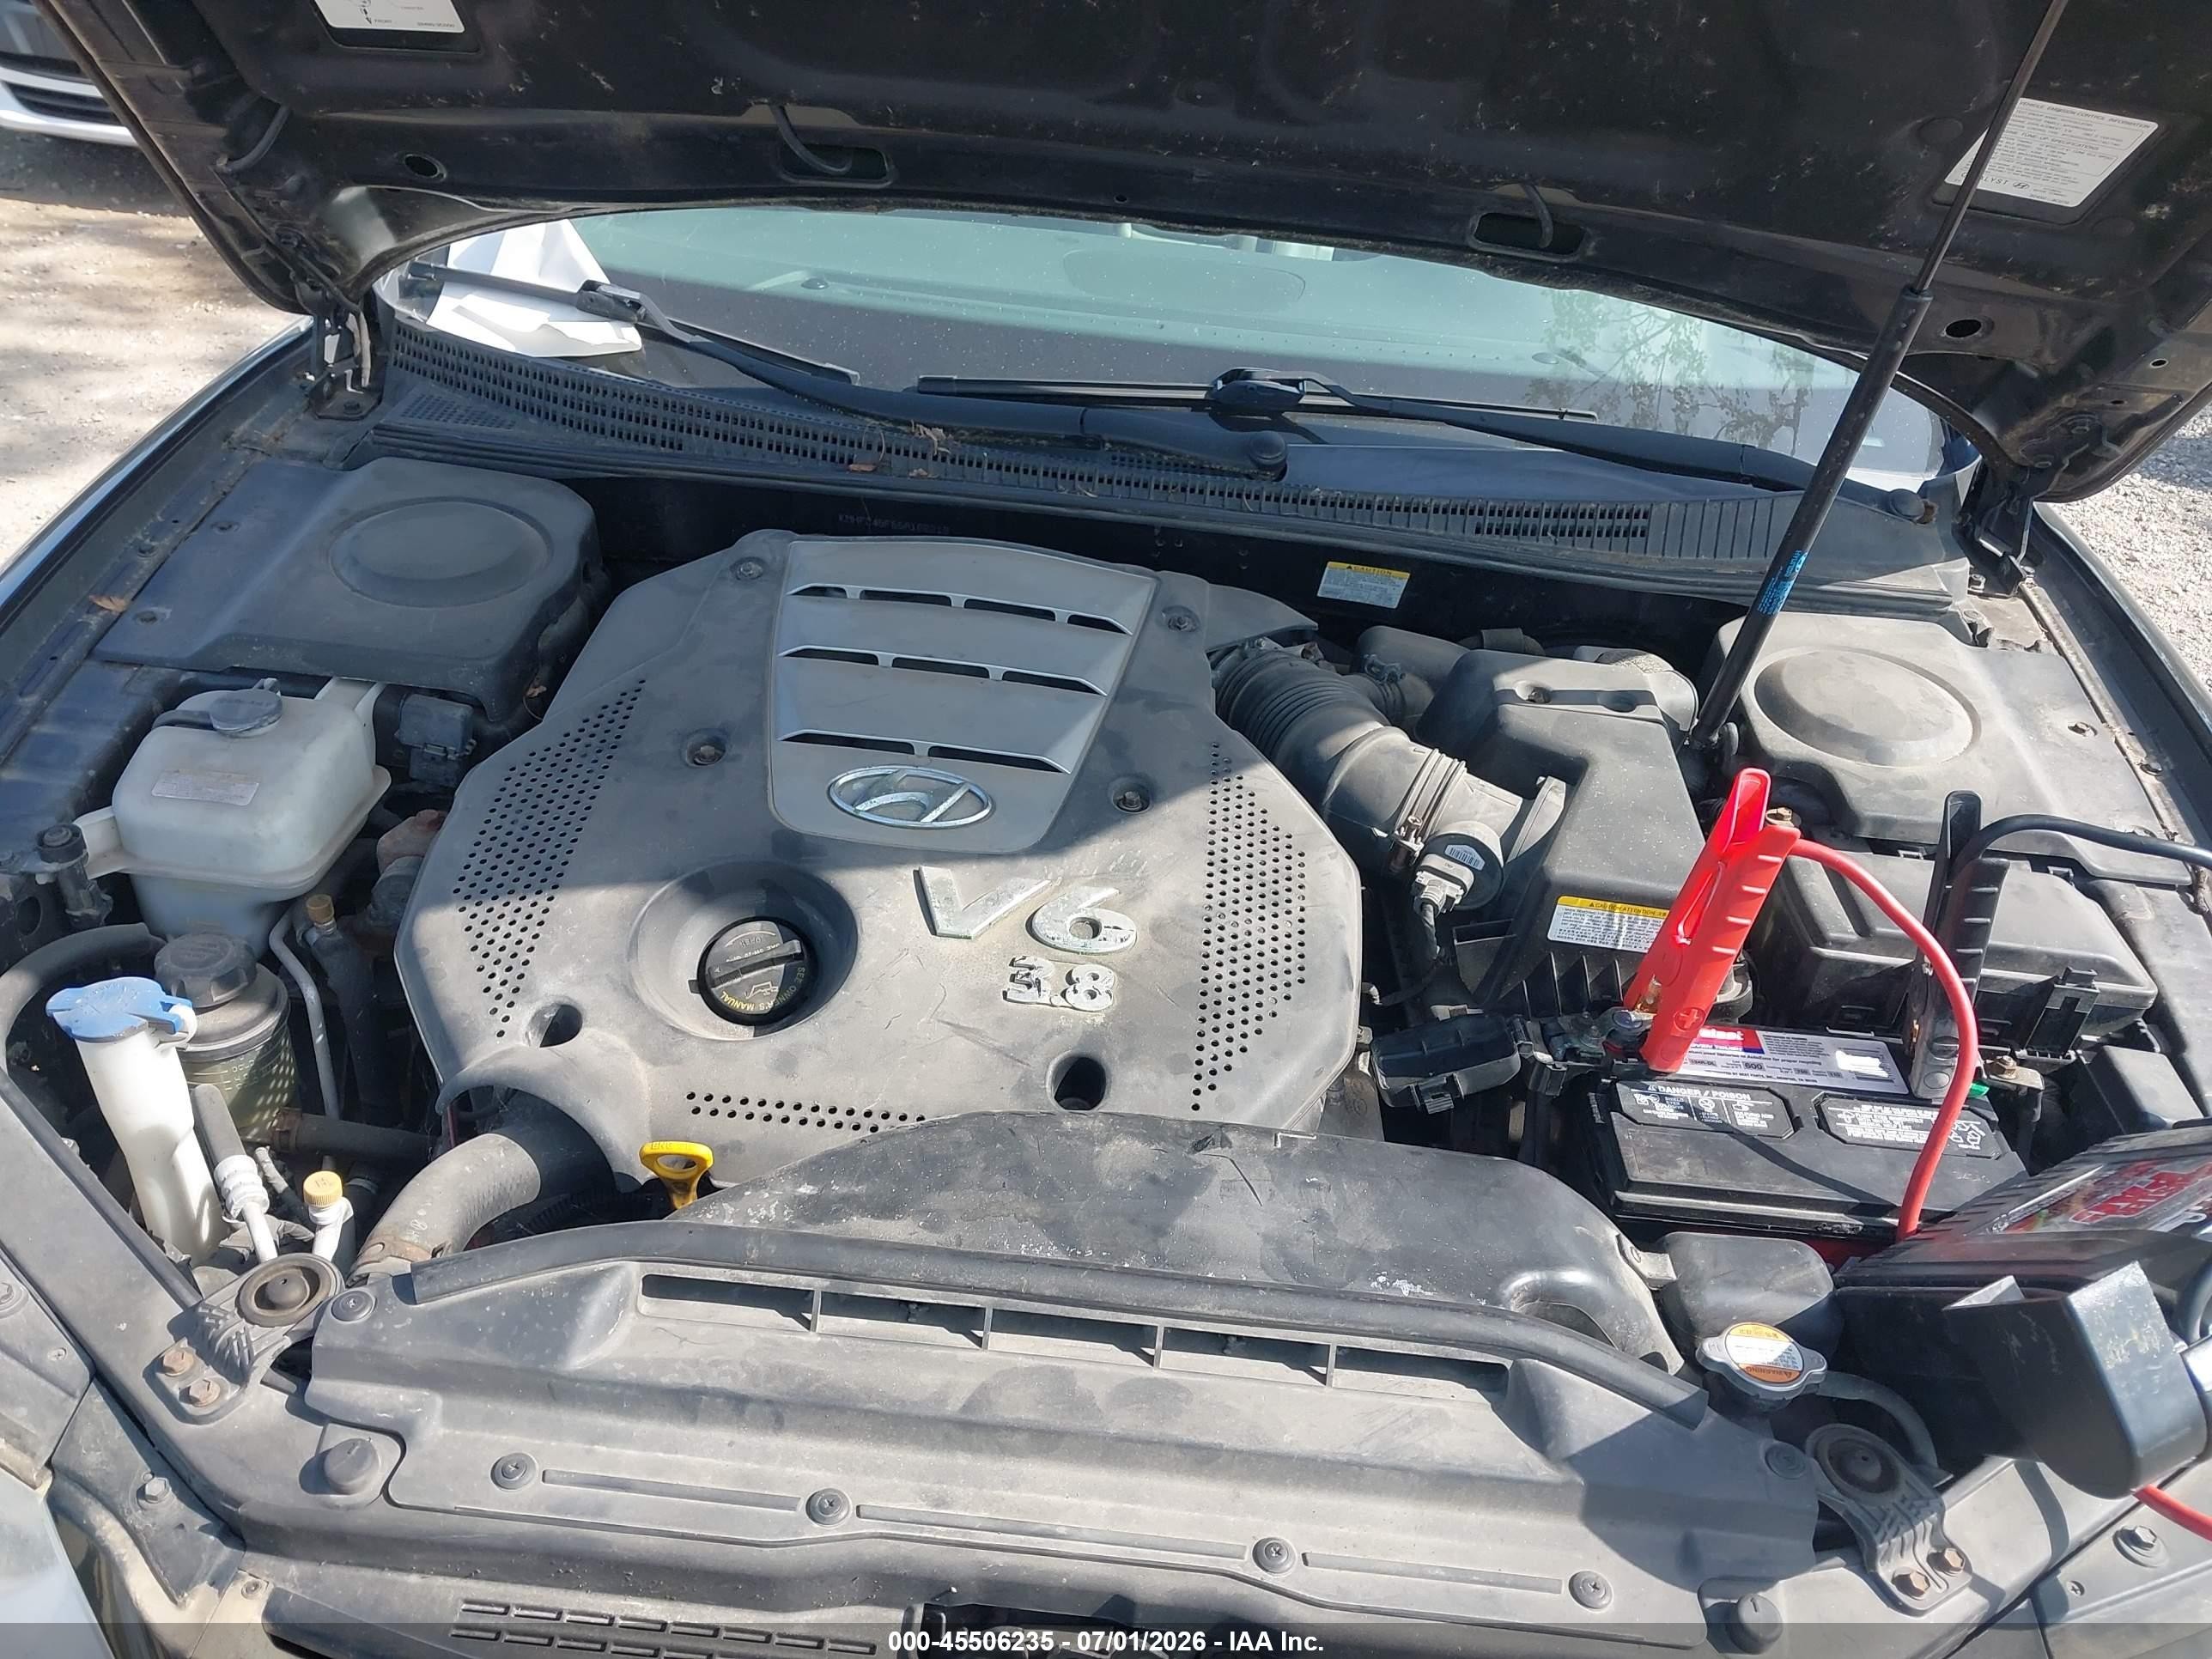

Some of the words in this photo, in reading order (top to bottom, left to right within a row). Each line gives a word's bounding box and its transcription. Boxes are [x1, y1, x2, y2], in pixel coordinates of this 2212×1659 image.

[917, 866, 1138, 955] V6
[721, 990, 755, 1012] MANUAL
[758, 985, 797, 1011] OWNER'S
[1744, 1062, 1763, 1071] 600
[1657, 1085, 1702, 1097] DANGER
[1711, 1091, 1751, 1101] POISON
